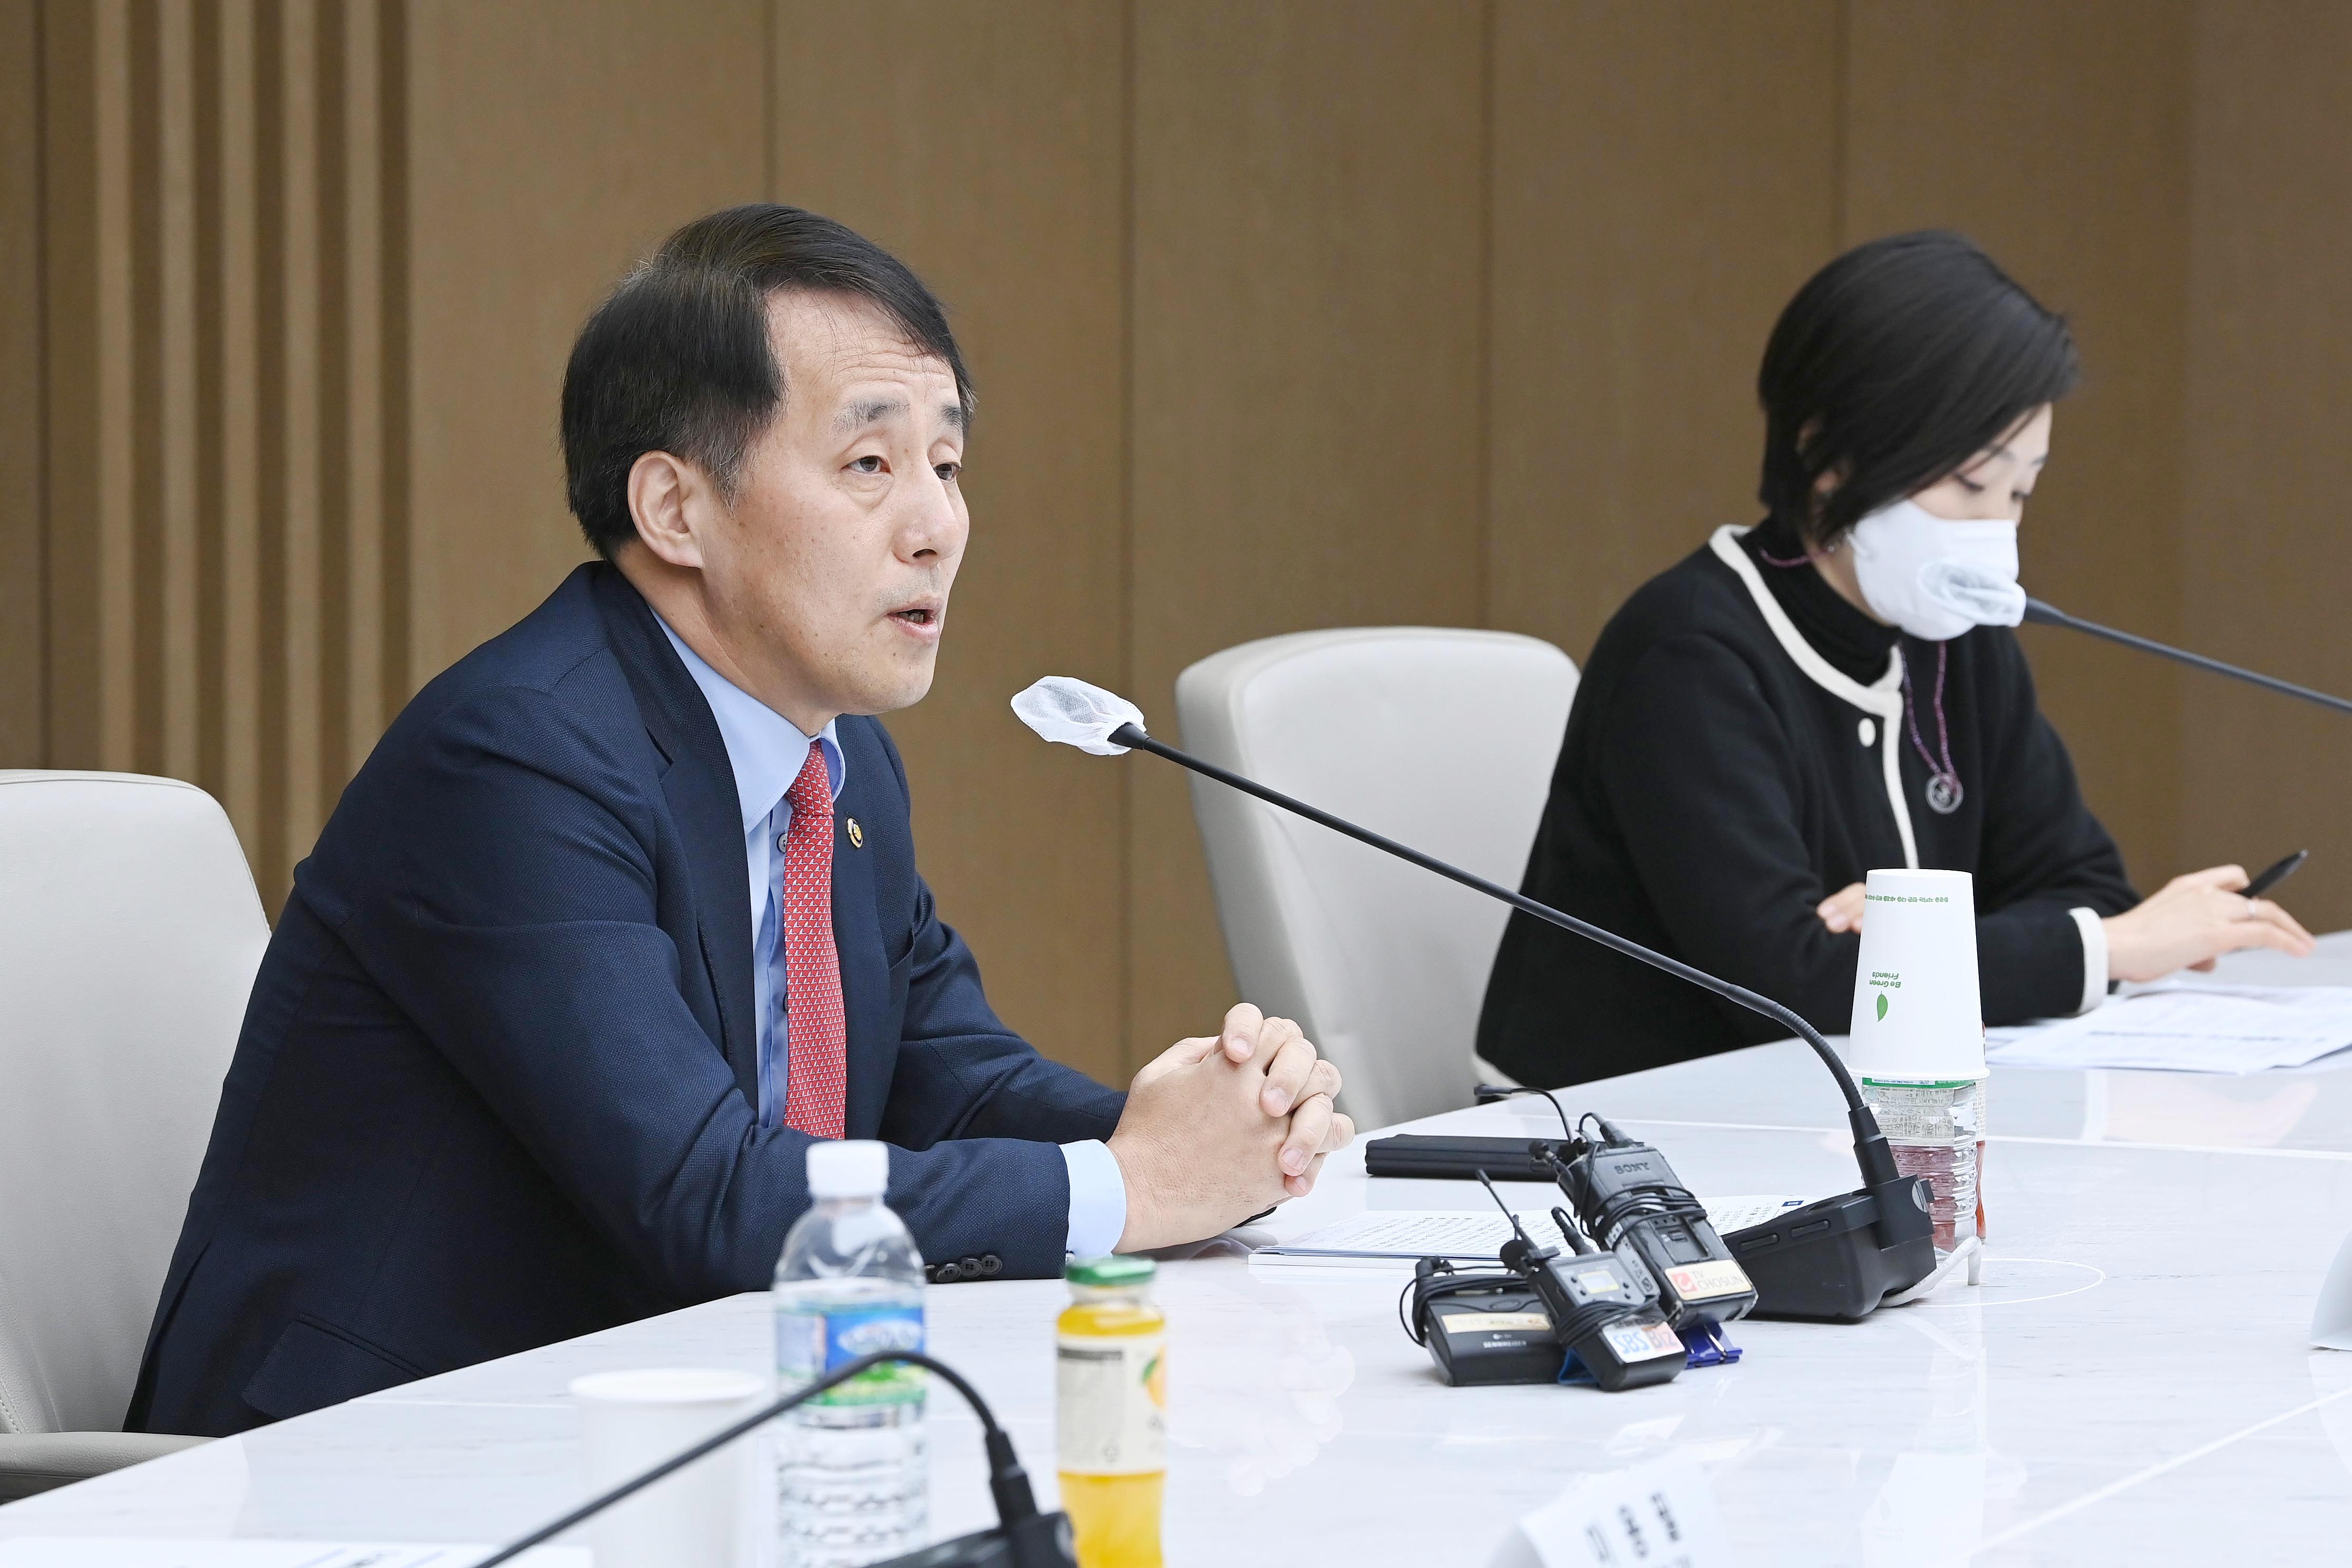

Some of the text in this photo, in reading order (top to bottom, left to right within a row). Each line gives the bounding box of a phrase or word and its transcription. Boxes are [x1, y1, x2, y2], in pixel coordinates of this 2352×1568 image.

[1615, 1162, 1649, 1174] SONY
[1697, 1274, 1743, 1289] CHOSUN
[1614, 1332, 1649, 1353] SBS
